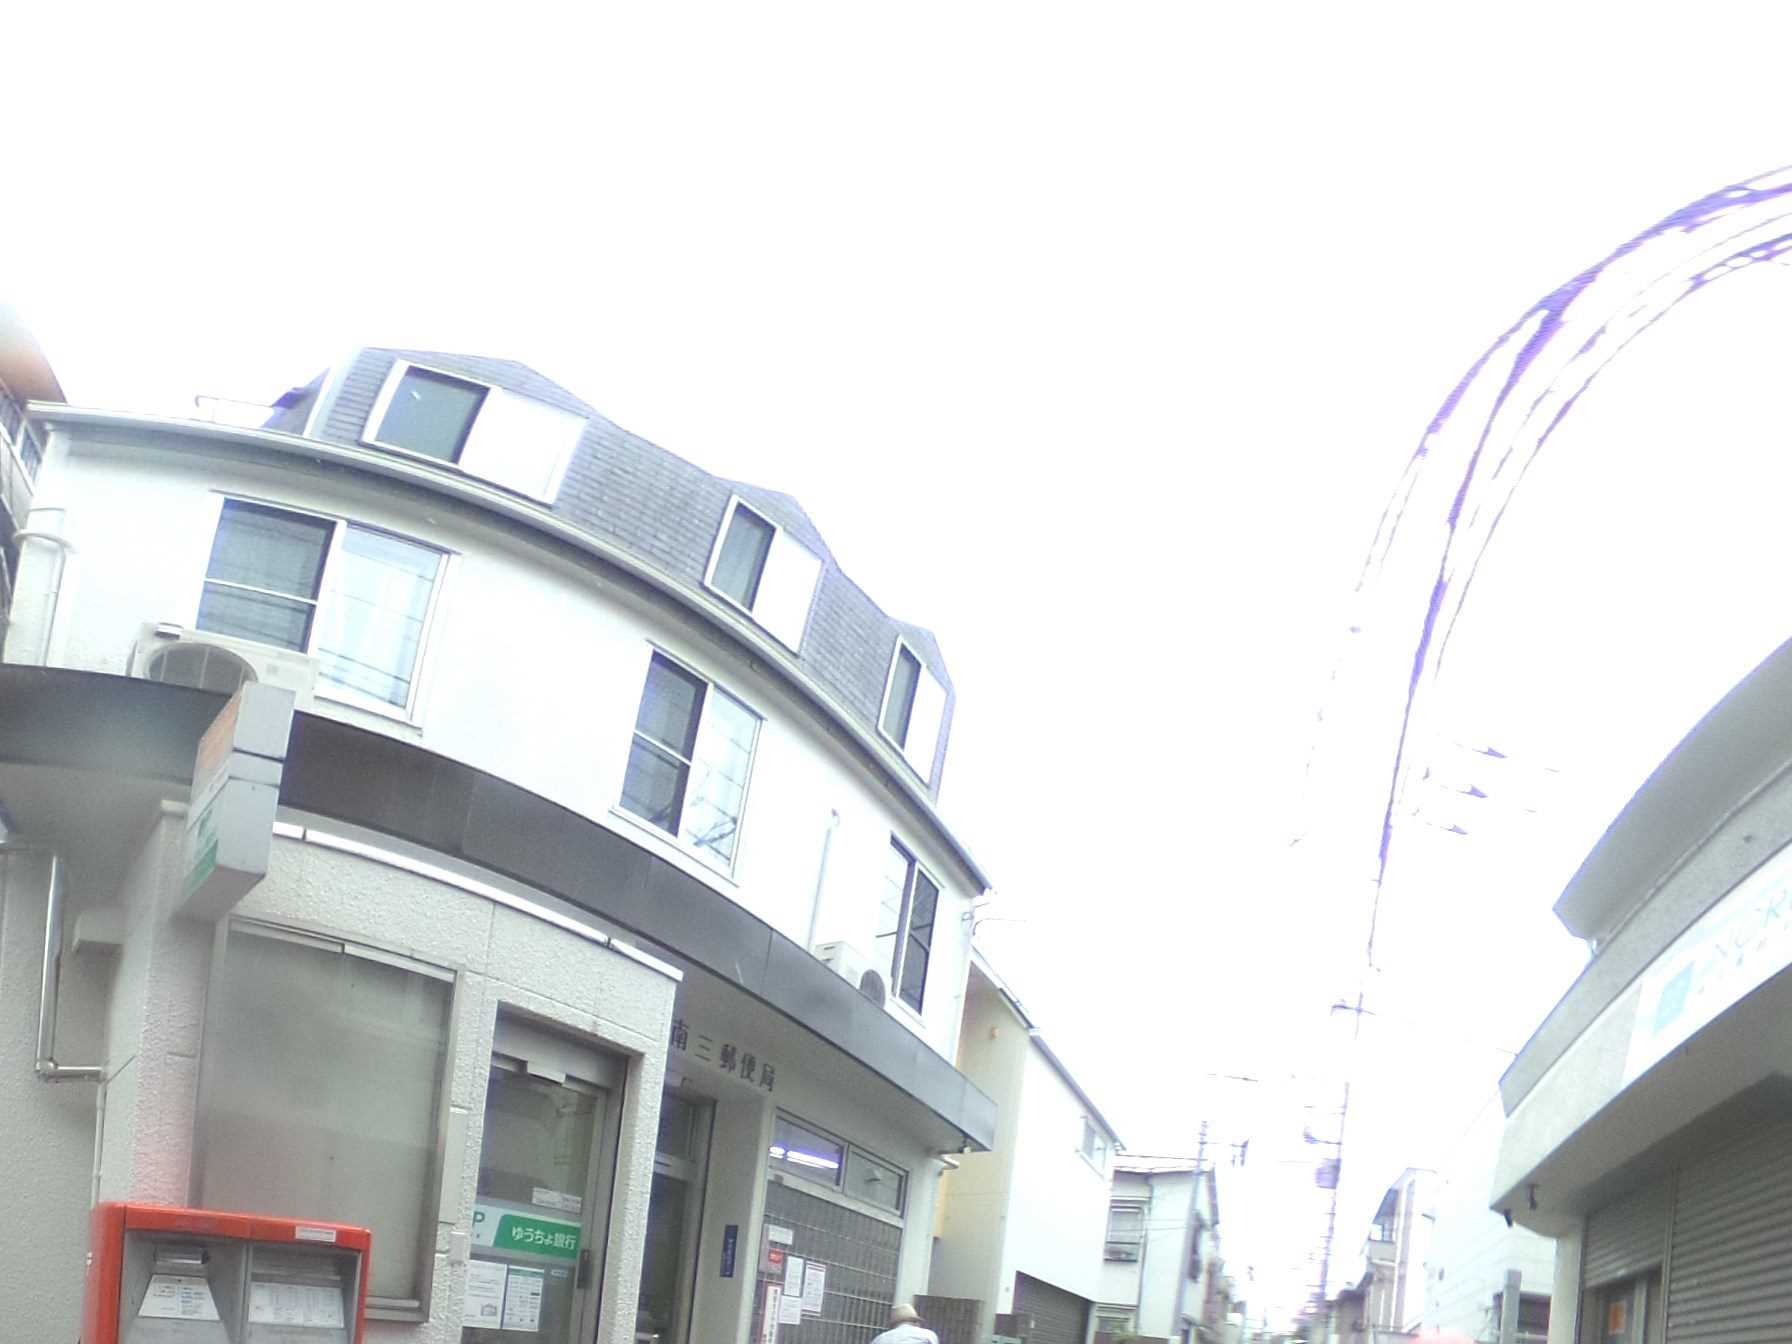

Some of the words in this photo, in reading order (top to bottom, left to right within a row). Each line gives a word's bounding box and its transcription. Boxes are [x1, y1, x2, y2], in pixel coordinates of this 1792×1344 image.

[511, 1226, 577, 1249] ゆうちょ銀行
